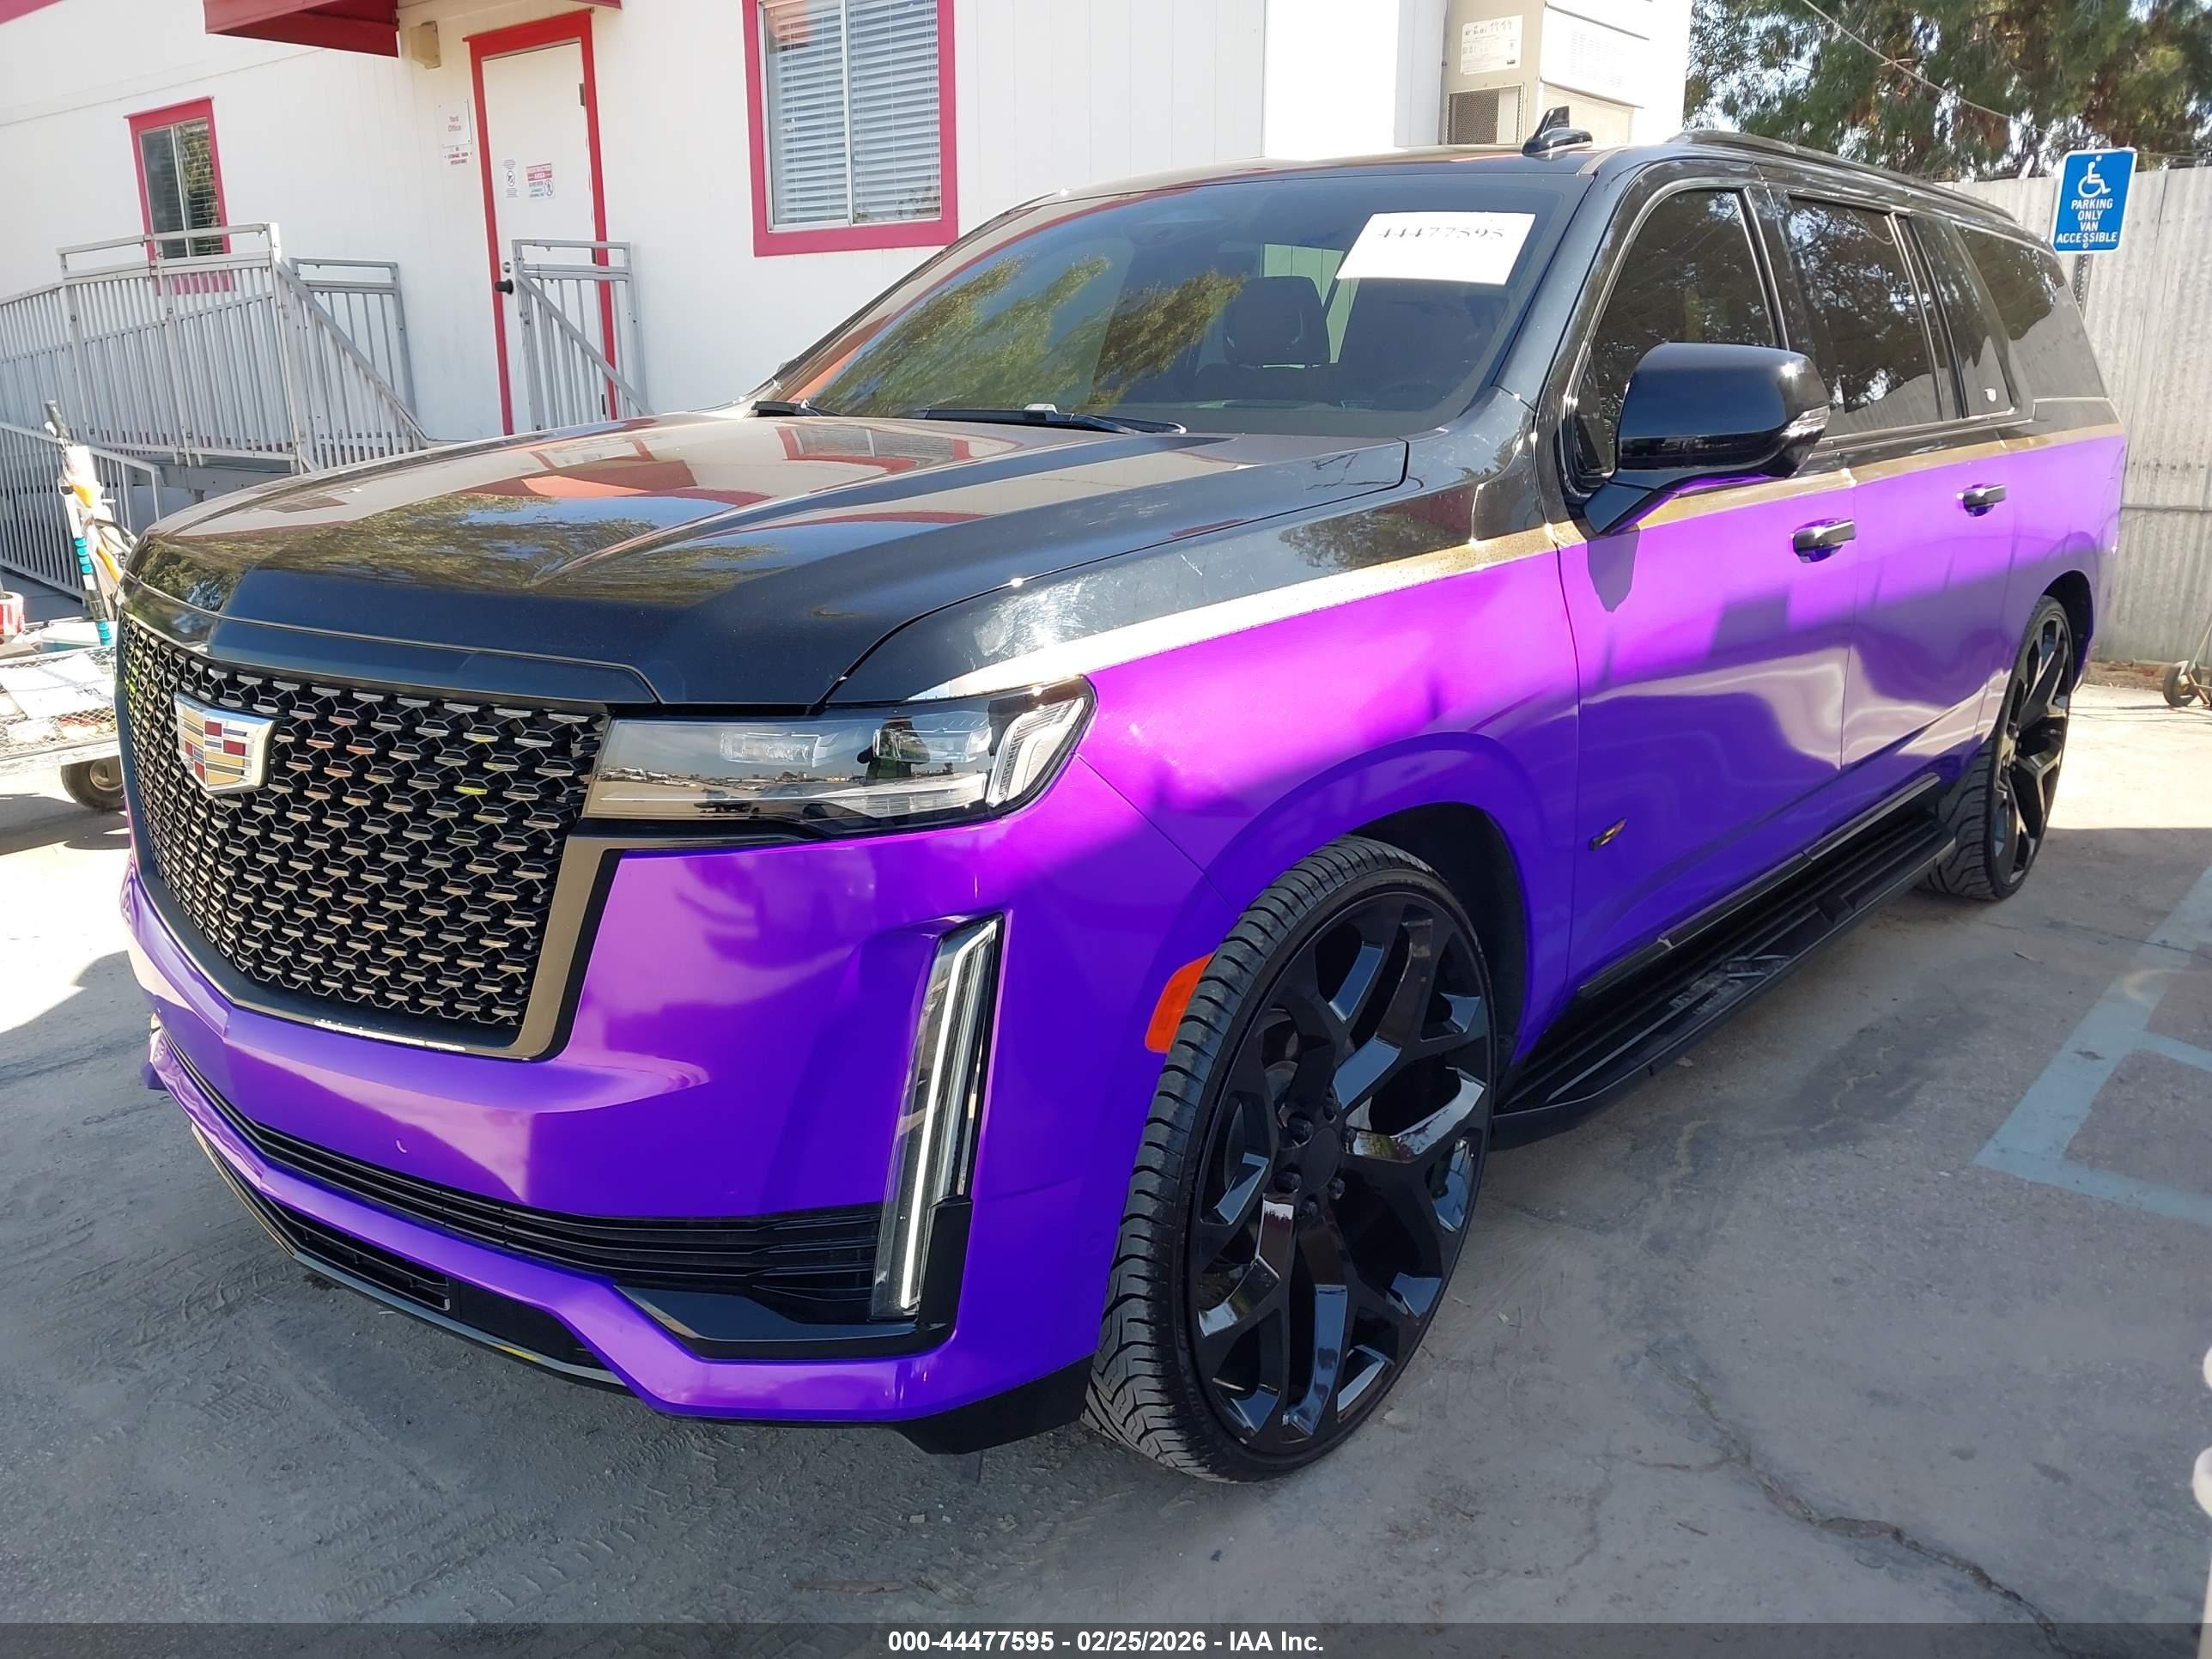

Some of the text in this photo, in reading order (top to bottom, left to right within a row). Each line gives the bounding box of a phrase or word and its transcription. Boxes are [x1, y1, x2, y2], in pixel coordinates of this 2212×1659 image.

[2070, 198, 2114, 210] PARKING
[2077, 210, 2104, 221] ONLY
[2080, 222, 2100, 232] VAN
[2056, 231, 2118, 244] ACCESSIBLE
